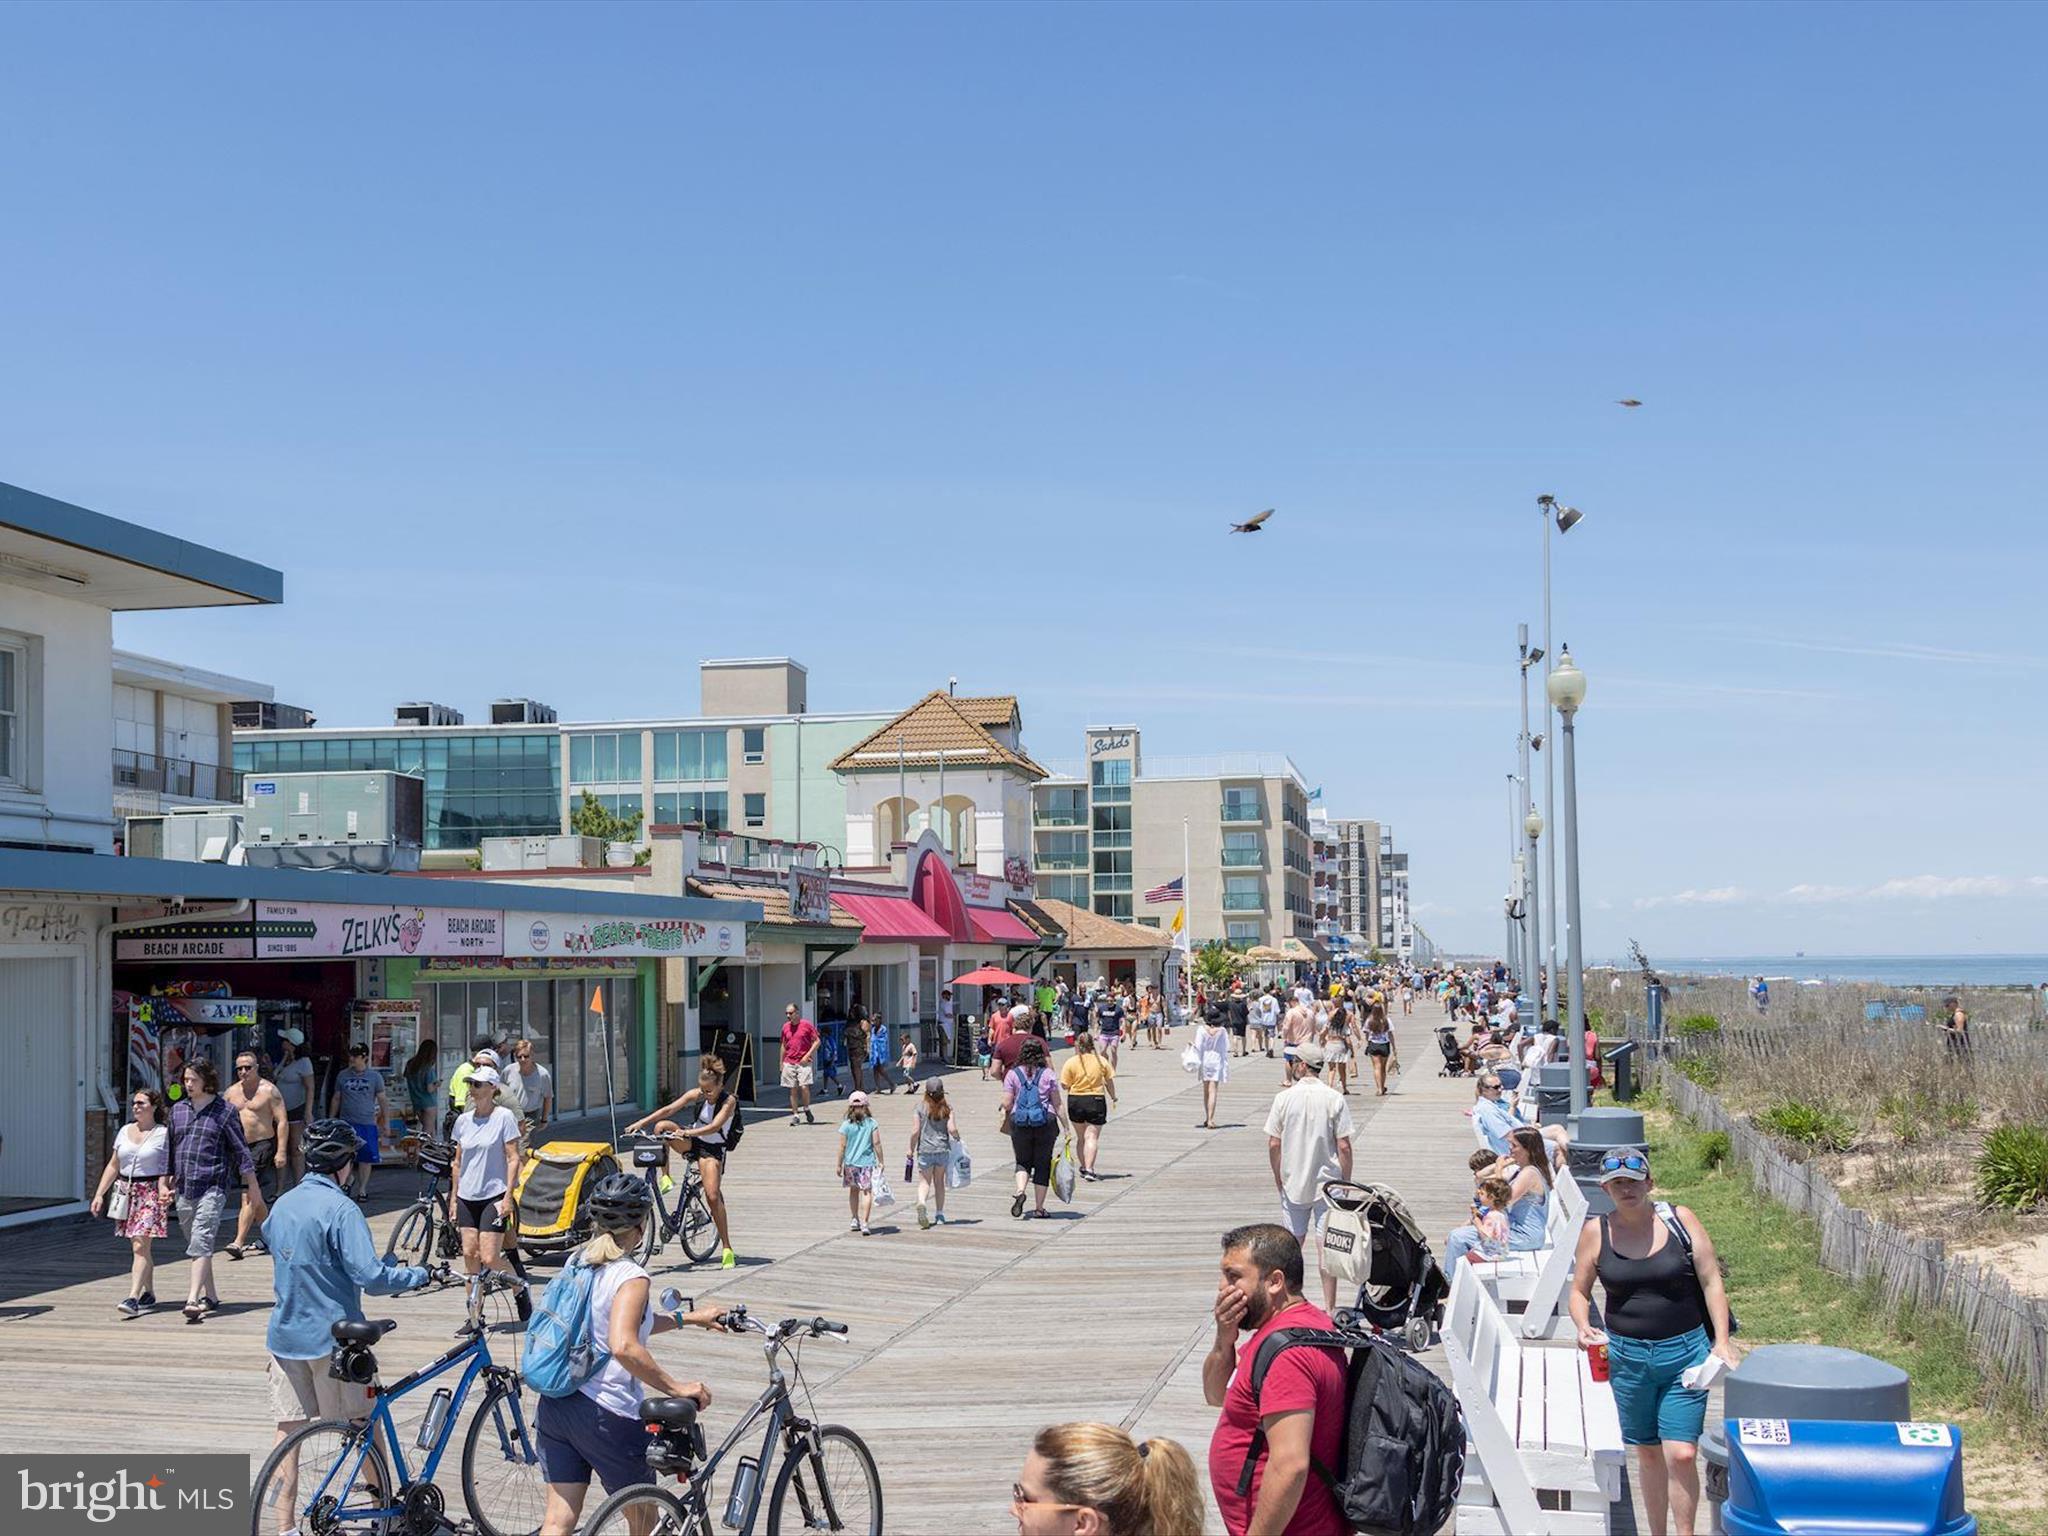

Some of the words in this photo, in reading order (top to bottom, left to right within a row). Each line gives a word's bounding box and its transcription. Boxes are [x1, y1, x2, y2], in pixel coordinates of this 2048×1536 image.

[1091, 734, 1129, 756] Sands
[266, 906, 285, 915] FAMILY
[286, 907, 298, 915] FUN
[3, 902, 86, 943] Taffy
[447, 918, 469, 934] BEACH
[471, 919, 496, 934] ARCADE
[461, 938, 484, 947] NORTH
[593, 922, 635, 950] BEACH
[640, 924, 683, 950] TREATS
[144, 943, 178, 955] BEACH
[182, 942, 224, 955] ARCADE
